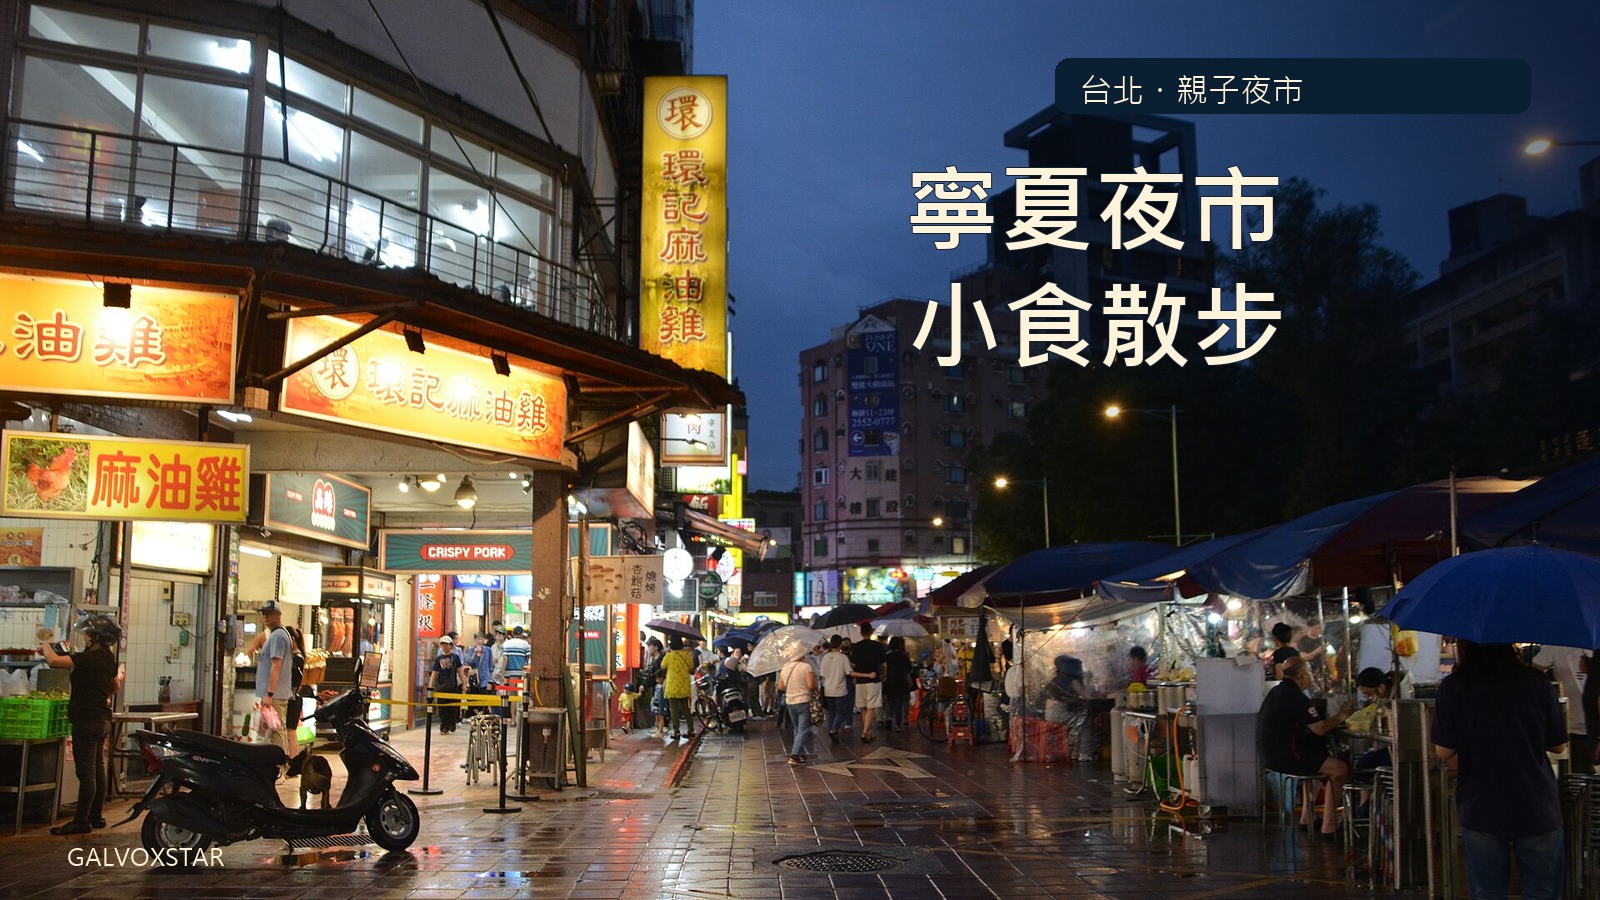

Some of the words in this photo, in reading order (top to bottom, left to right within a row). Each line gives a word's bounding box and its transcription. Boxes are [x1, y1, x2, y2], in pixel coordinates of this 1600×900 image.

[664, 94, 702, 132] 環
[660, 149, 707, 343] 環記麻油雞
[91, 450, 241, 512] 麻油雞
[427, 546, 470, 558] CRISPY
[474, 546, 506, 558] PORK
[630, 563, 643, 599] 杏鮑菇
[644, 571, 657, 594] 燒烤
